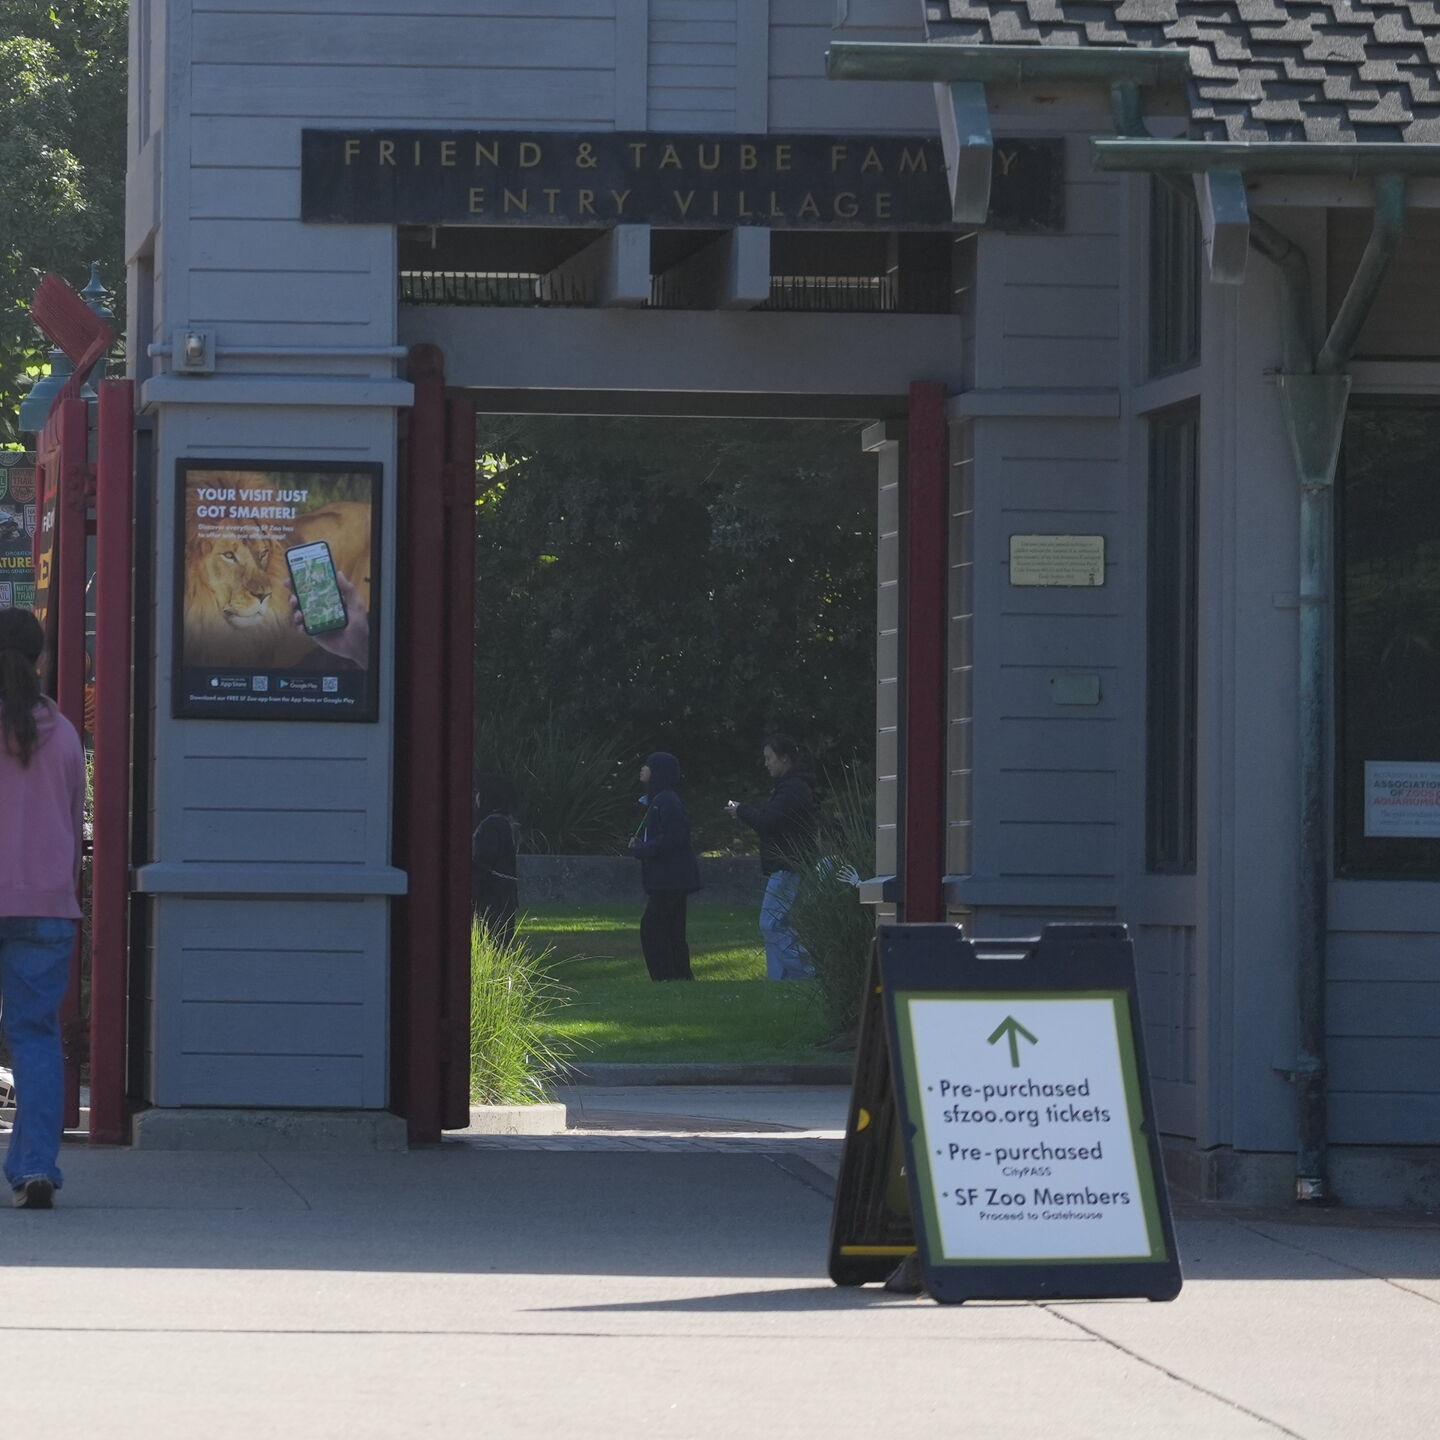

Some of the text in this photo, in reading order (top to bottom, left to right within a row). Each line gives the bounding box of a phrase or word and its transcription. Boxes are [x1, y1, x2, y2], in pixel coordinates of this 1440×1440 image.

[344, 140, 1018, 176] FRIEND & TAUBE FAMY
[469, 187, 892, 219] ENTRY VILLAGE
[197, 488, 309, 503] YOUR VISIT JUST
[197, 505, 296, 520] GOT SMARTER!
[17, 592, 34, 601] TRAI
[940, 1078, 1090, 1102] Pre-purchased
[943, 1104, 1111, 1127] sfzoo.org tickets
[948, 1141, 1103, 1166] Pre-purchased
[1002, 1166, 1052, 1179] CityPASS
[955, 1186, 1131, 1206] SF Zoo Members
[979, 1210, 1103, 1221] Proceed to Gatehouse
